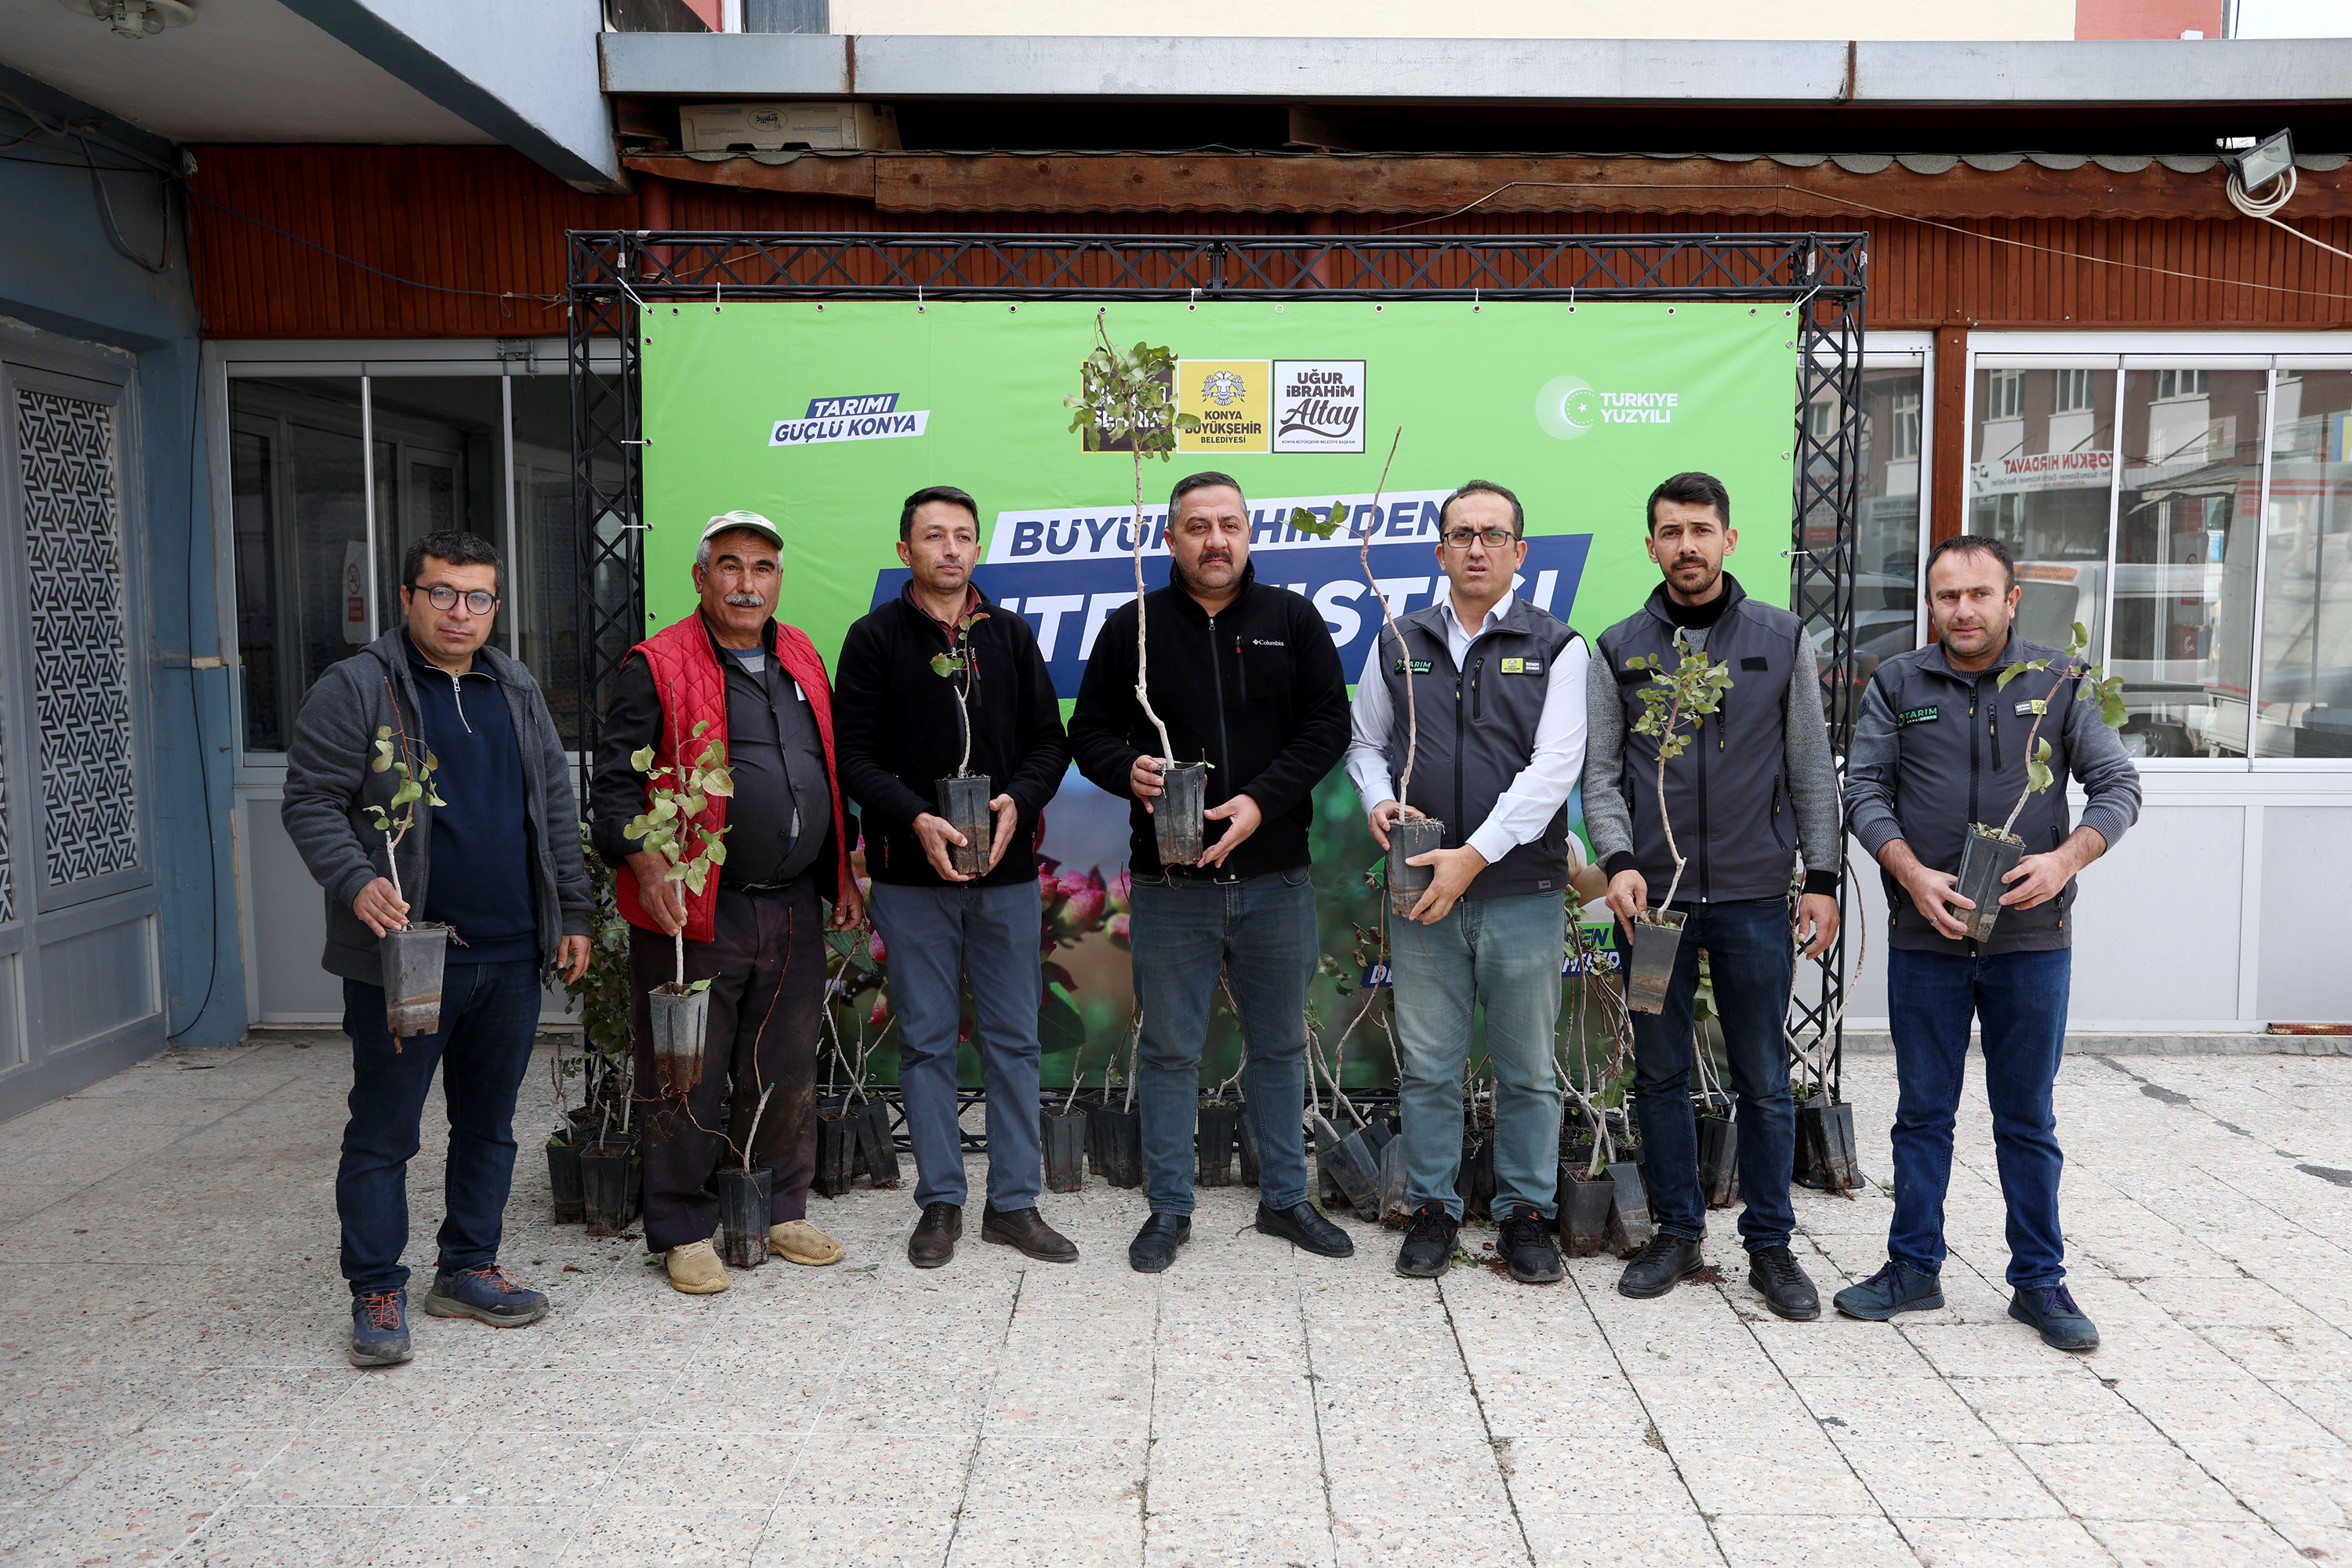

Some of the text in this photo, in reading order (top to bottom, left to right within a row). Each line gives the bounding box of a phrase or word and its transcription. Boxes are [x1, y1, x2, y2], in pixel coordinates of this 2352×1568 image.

[1297, 368, 1343, 384] UĞUR
[815, 396, 893, 418] TARIMI
[1600, 392, 1679, 407] TÜRKİYE
[1204, 411, 1243, 420] KONYA
[1279, 398, 1359, 437] Altay
[1600, 408, 1671, 423] YÜZYILI
[775, 415, 916, 443] GÜÇLÜ KONYA
[1200, 435, 1247, 444] BELEDİYESİ
[1905, 707, 1937, 720] TARIM
